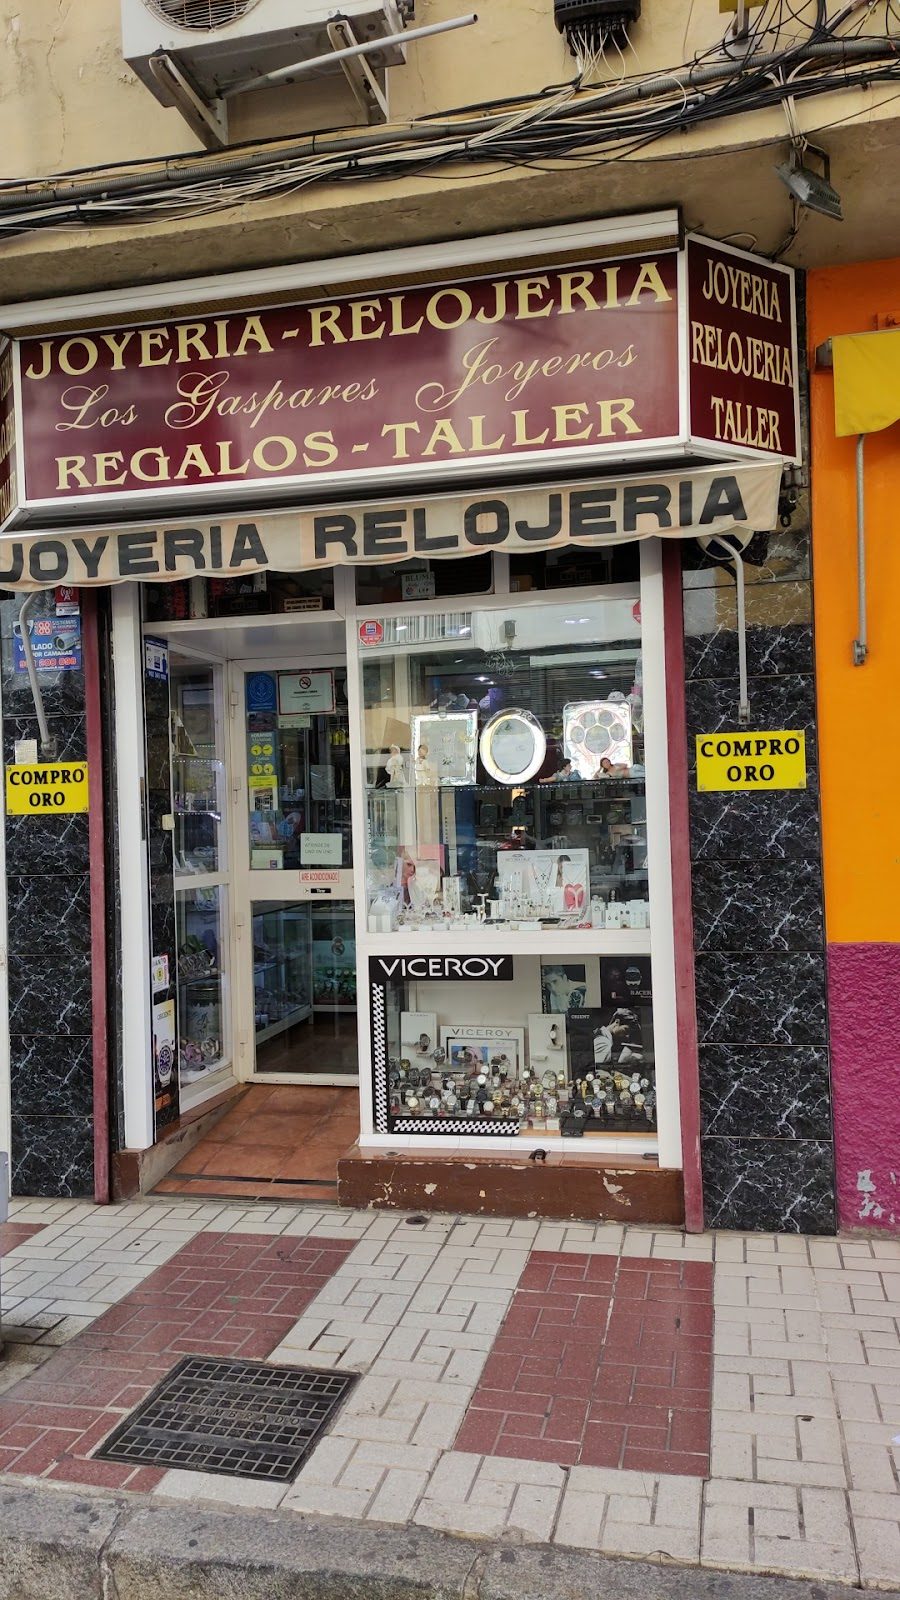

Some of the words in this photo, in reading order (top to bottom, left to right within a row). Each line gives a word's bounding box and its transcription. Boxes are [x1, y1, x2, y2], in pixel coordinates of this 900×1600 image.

[702, 258, 783, 323] JOYERIA
[25, 315, 275, 380] JOYERIA
[308, 261, 673, 347] RELOJERIA
[690, 320, 794, 388] RELOJERIA
[54, 384, 138, 432] Los
[164, 370, 379, 430] Gaspares
[414, 336, 638, 413] Joyeros
[710, 394, 783, 452] TALLER
[55, 431, 340, 491] REGALOS
[381, 397, 643, 459] TALLER
[0, 522, 269, 583] JOYERIA
[313, 475, 748, 559] RELOJERIA
[700, 738, 800, 757] COMPRO
[9, 768, 85, 785] COMPRO
[727, 764, 775, 782] ORO
[29, 791, 66, 807] ORO
[378, 957, 505, 977] VICEROY
[451, 1028, 513, 1037] VICEROY
[168, 1403, 301, 1426] ALUMBRADO
